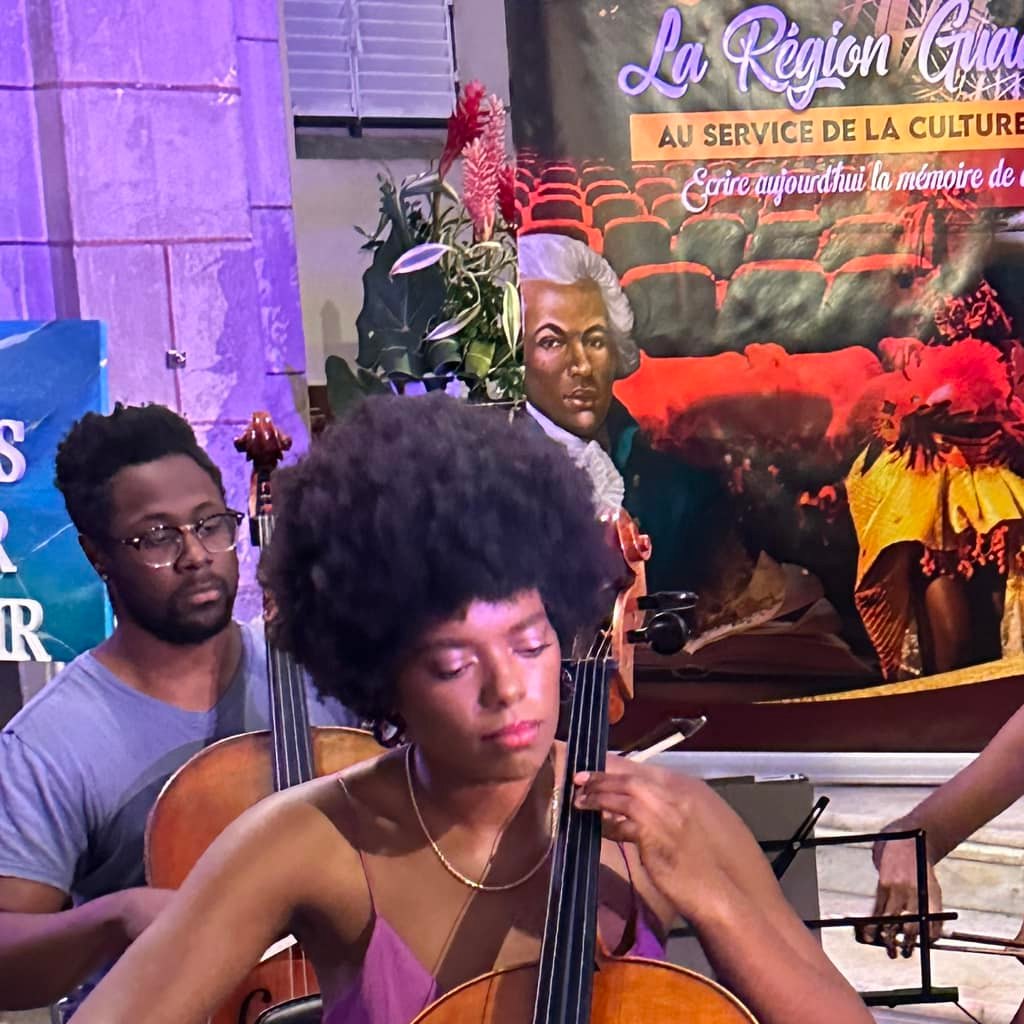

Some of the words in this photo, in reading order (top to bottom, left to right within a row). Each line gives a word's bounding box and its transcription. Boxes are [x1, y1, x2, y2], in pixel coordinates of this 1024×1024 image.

[617, 6, 708, 99] La
[722, 3, 893, 110] Région
[658, 124, 694, 149] AU
[703, 120, 814, 147] SERVICE
[822, 118, 857, 143] DE
[865, 116, 901, 141] LA
[754, 159, 868, 208] aujourd'hui
[870, 159, 893, 187] la
[896, 161, 985, 192] mémoire
[988, 157, 1016, 188] de
